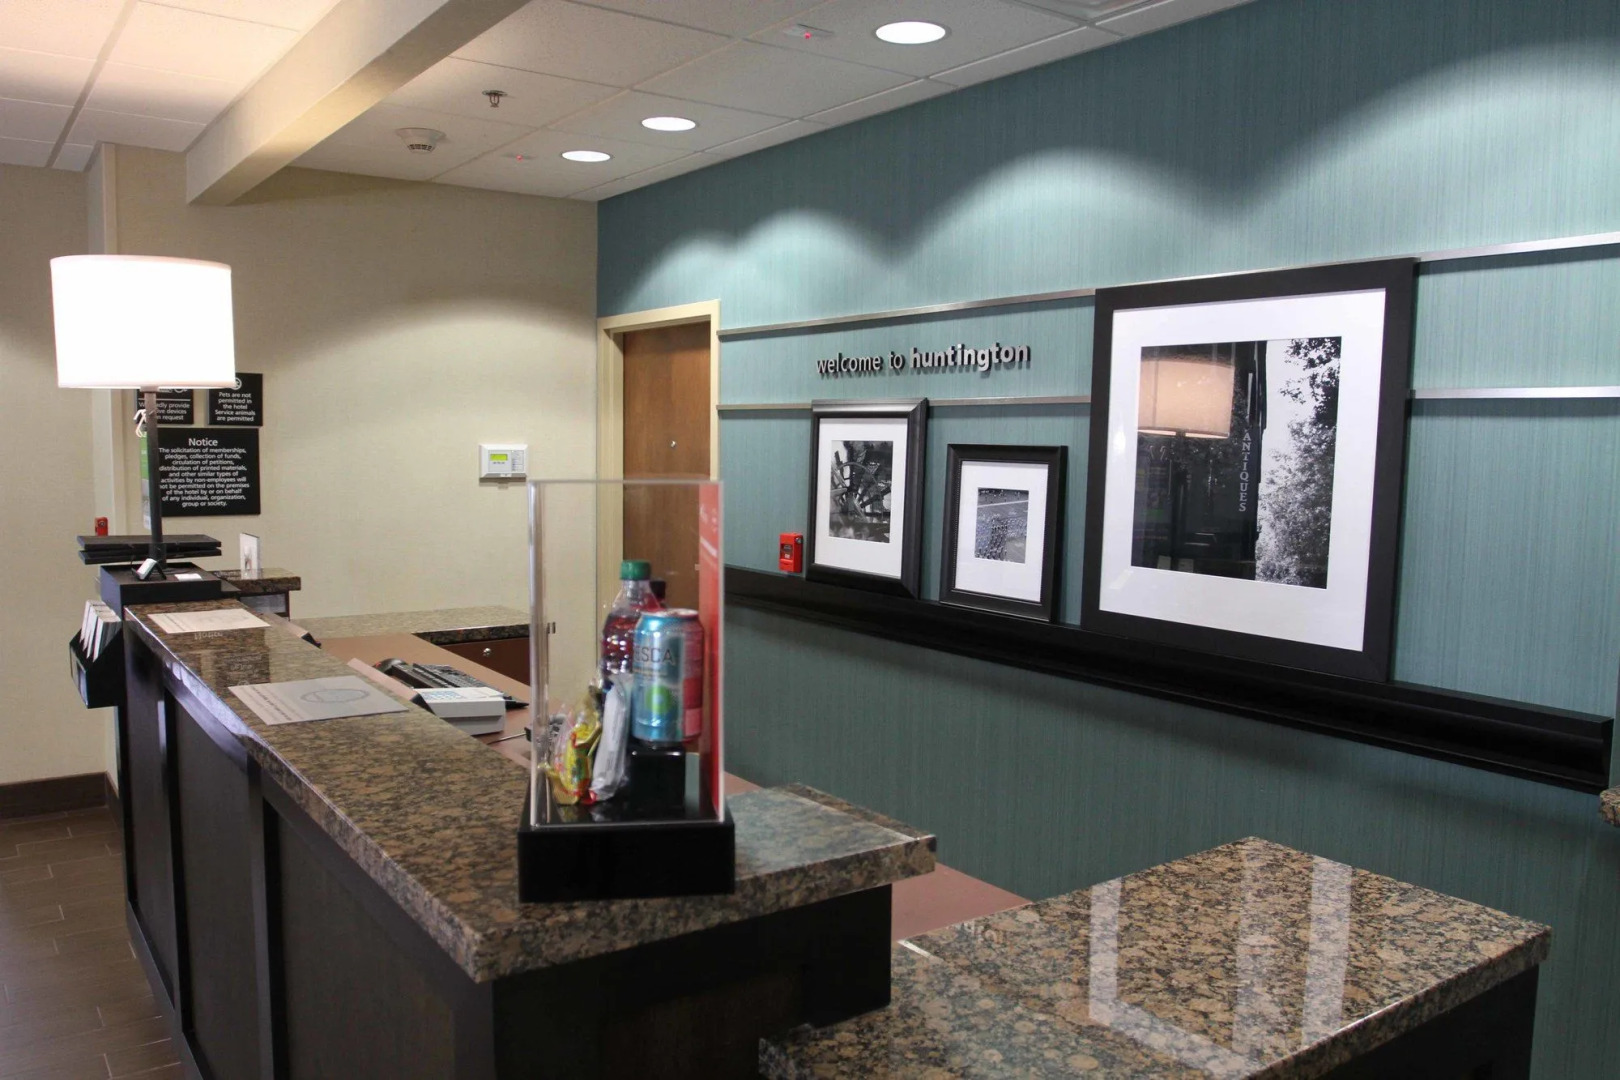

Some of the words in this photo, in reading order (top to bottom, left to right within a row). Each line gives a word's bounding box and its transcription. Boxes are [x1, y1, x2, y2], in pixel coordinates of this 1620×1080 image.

[816, 353, 882, 373] welcome
[887, 351, 904, 370] to
[910, 342, 1029, 372] huntington
[188, 438, 218, 446] Notice
[1238, 432, 1252, 512] ANTIQUES
[633, 646, 673, 663] ESCA
